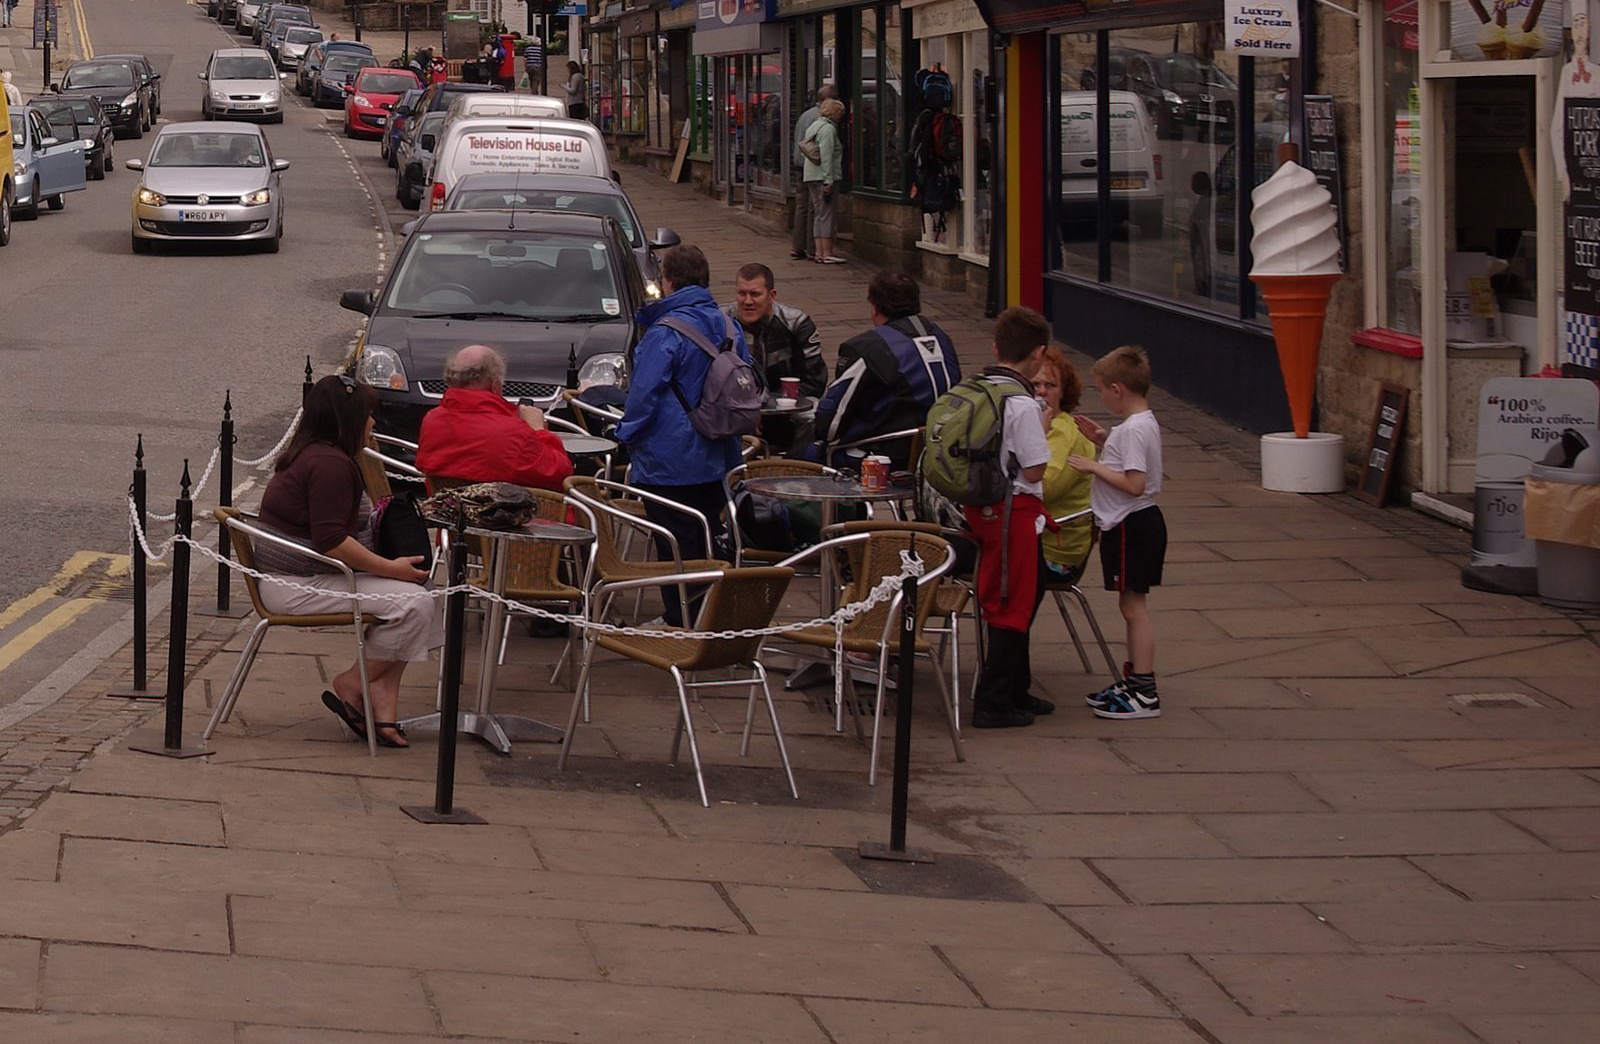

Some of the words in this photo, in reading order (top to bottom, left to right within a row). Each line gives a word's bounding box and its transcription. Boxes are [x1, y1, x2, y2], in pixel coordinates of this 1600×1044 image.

[1241, 6, 1283, 17] Luxury
[1234, 16, 1250, 25] Ice
[1254, 17, 1291, 27] Cream
[1234, 38, 1260, 48] Sold
[1264, 40, 1291, 49] Here
[469, 136, 522, 150] Television
[525, 138, 561, 152] House
[564, 140, 582, 153] Ltd
[1574, 131, 1599, 156] PORK
[209, 212, 225, 220] APY
[1575, 240, 1600, 266] BEEF
[1498, 414, 1543, 424] Arabica
